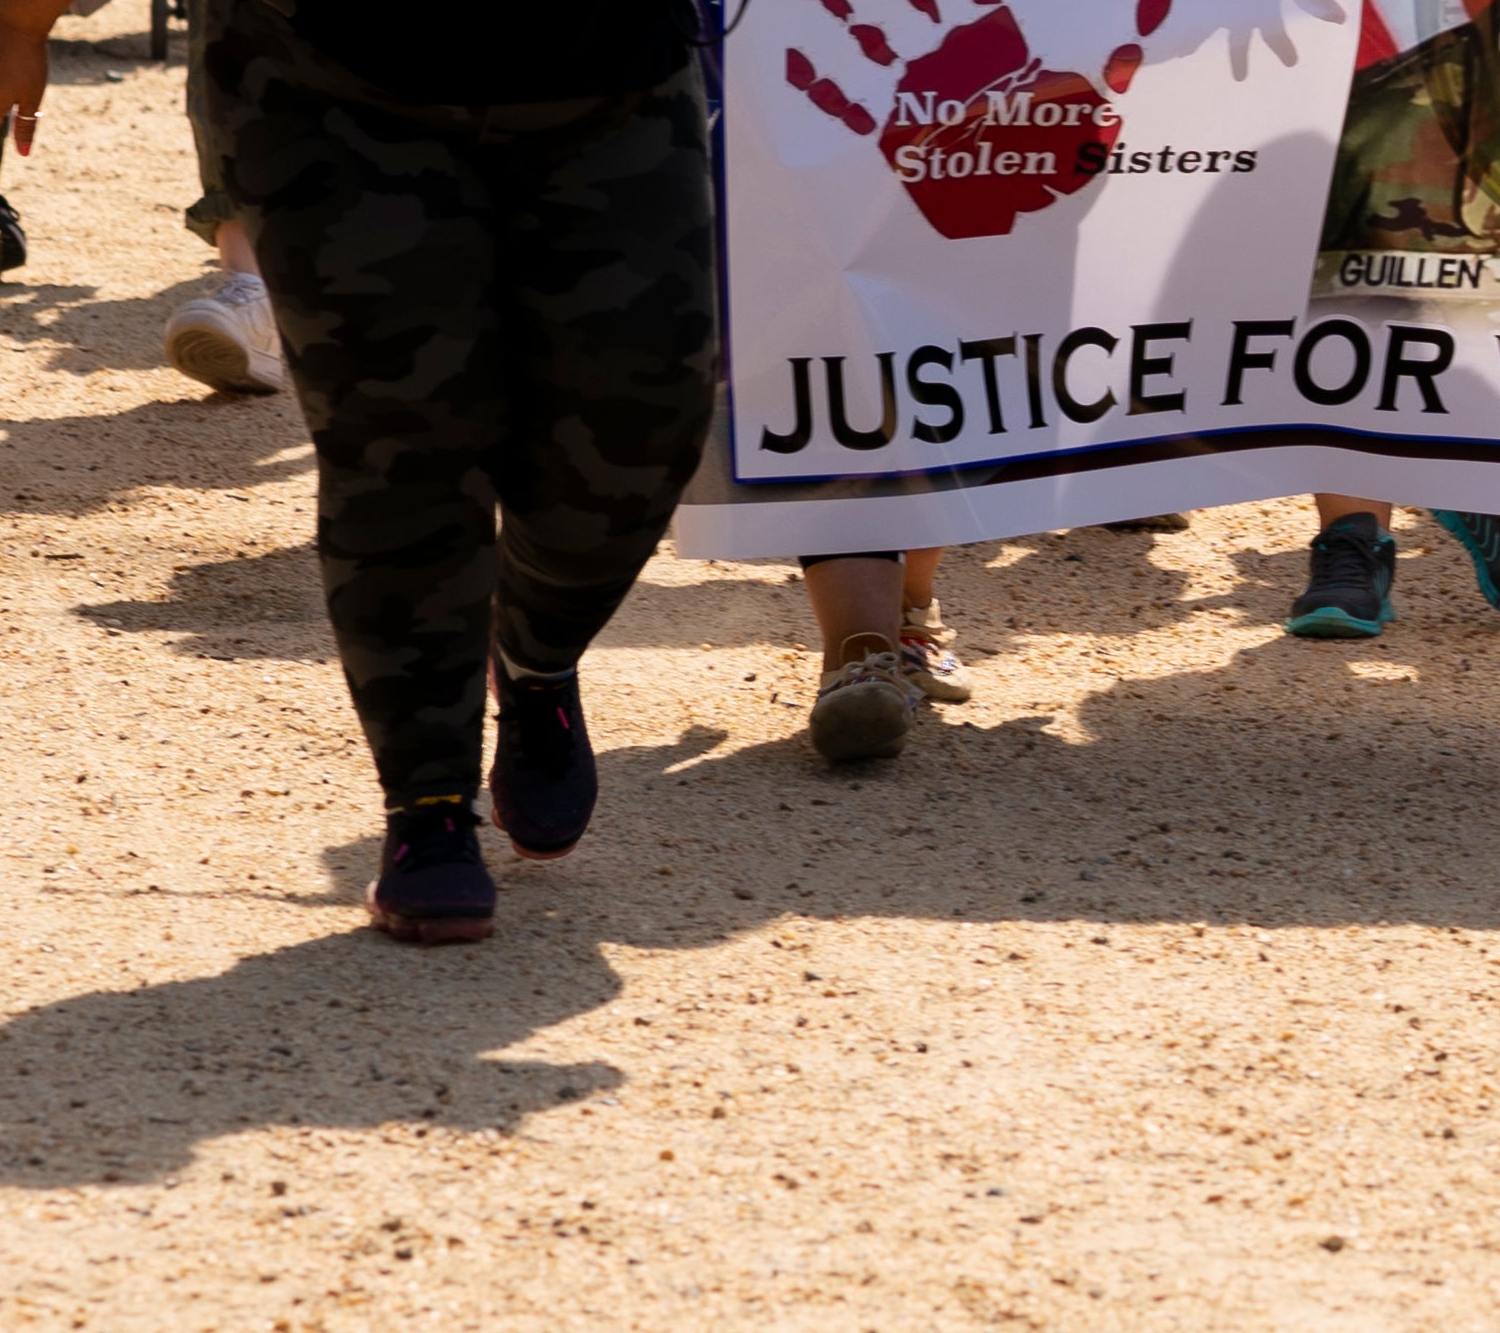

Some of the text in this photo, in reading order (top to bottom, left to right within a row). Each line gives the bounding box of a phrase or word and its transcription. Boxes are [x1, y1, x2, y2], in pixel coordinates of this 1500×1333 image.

[895, 90, 1122, 129] No More
[895, 138, 1258, 184] Stolen Sisters
[1338, 253, 1484, 290] GUILLEN
[760, 321, 1194, 454] JUSTICE
[1218, 315, 1457, 415] FOR
